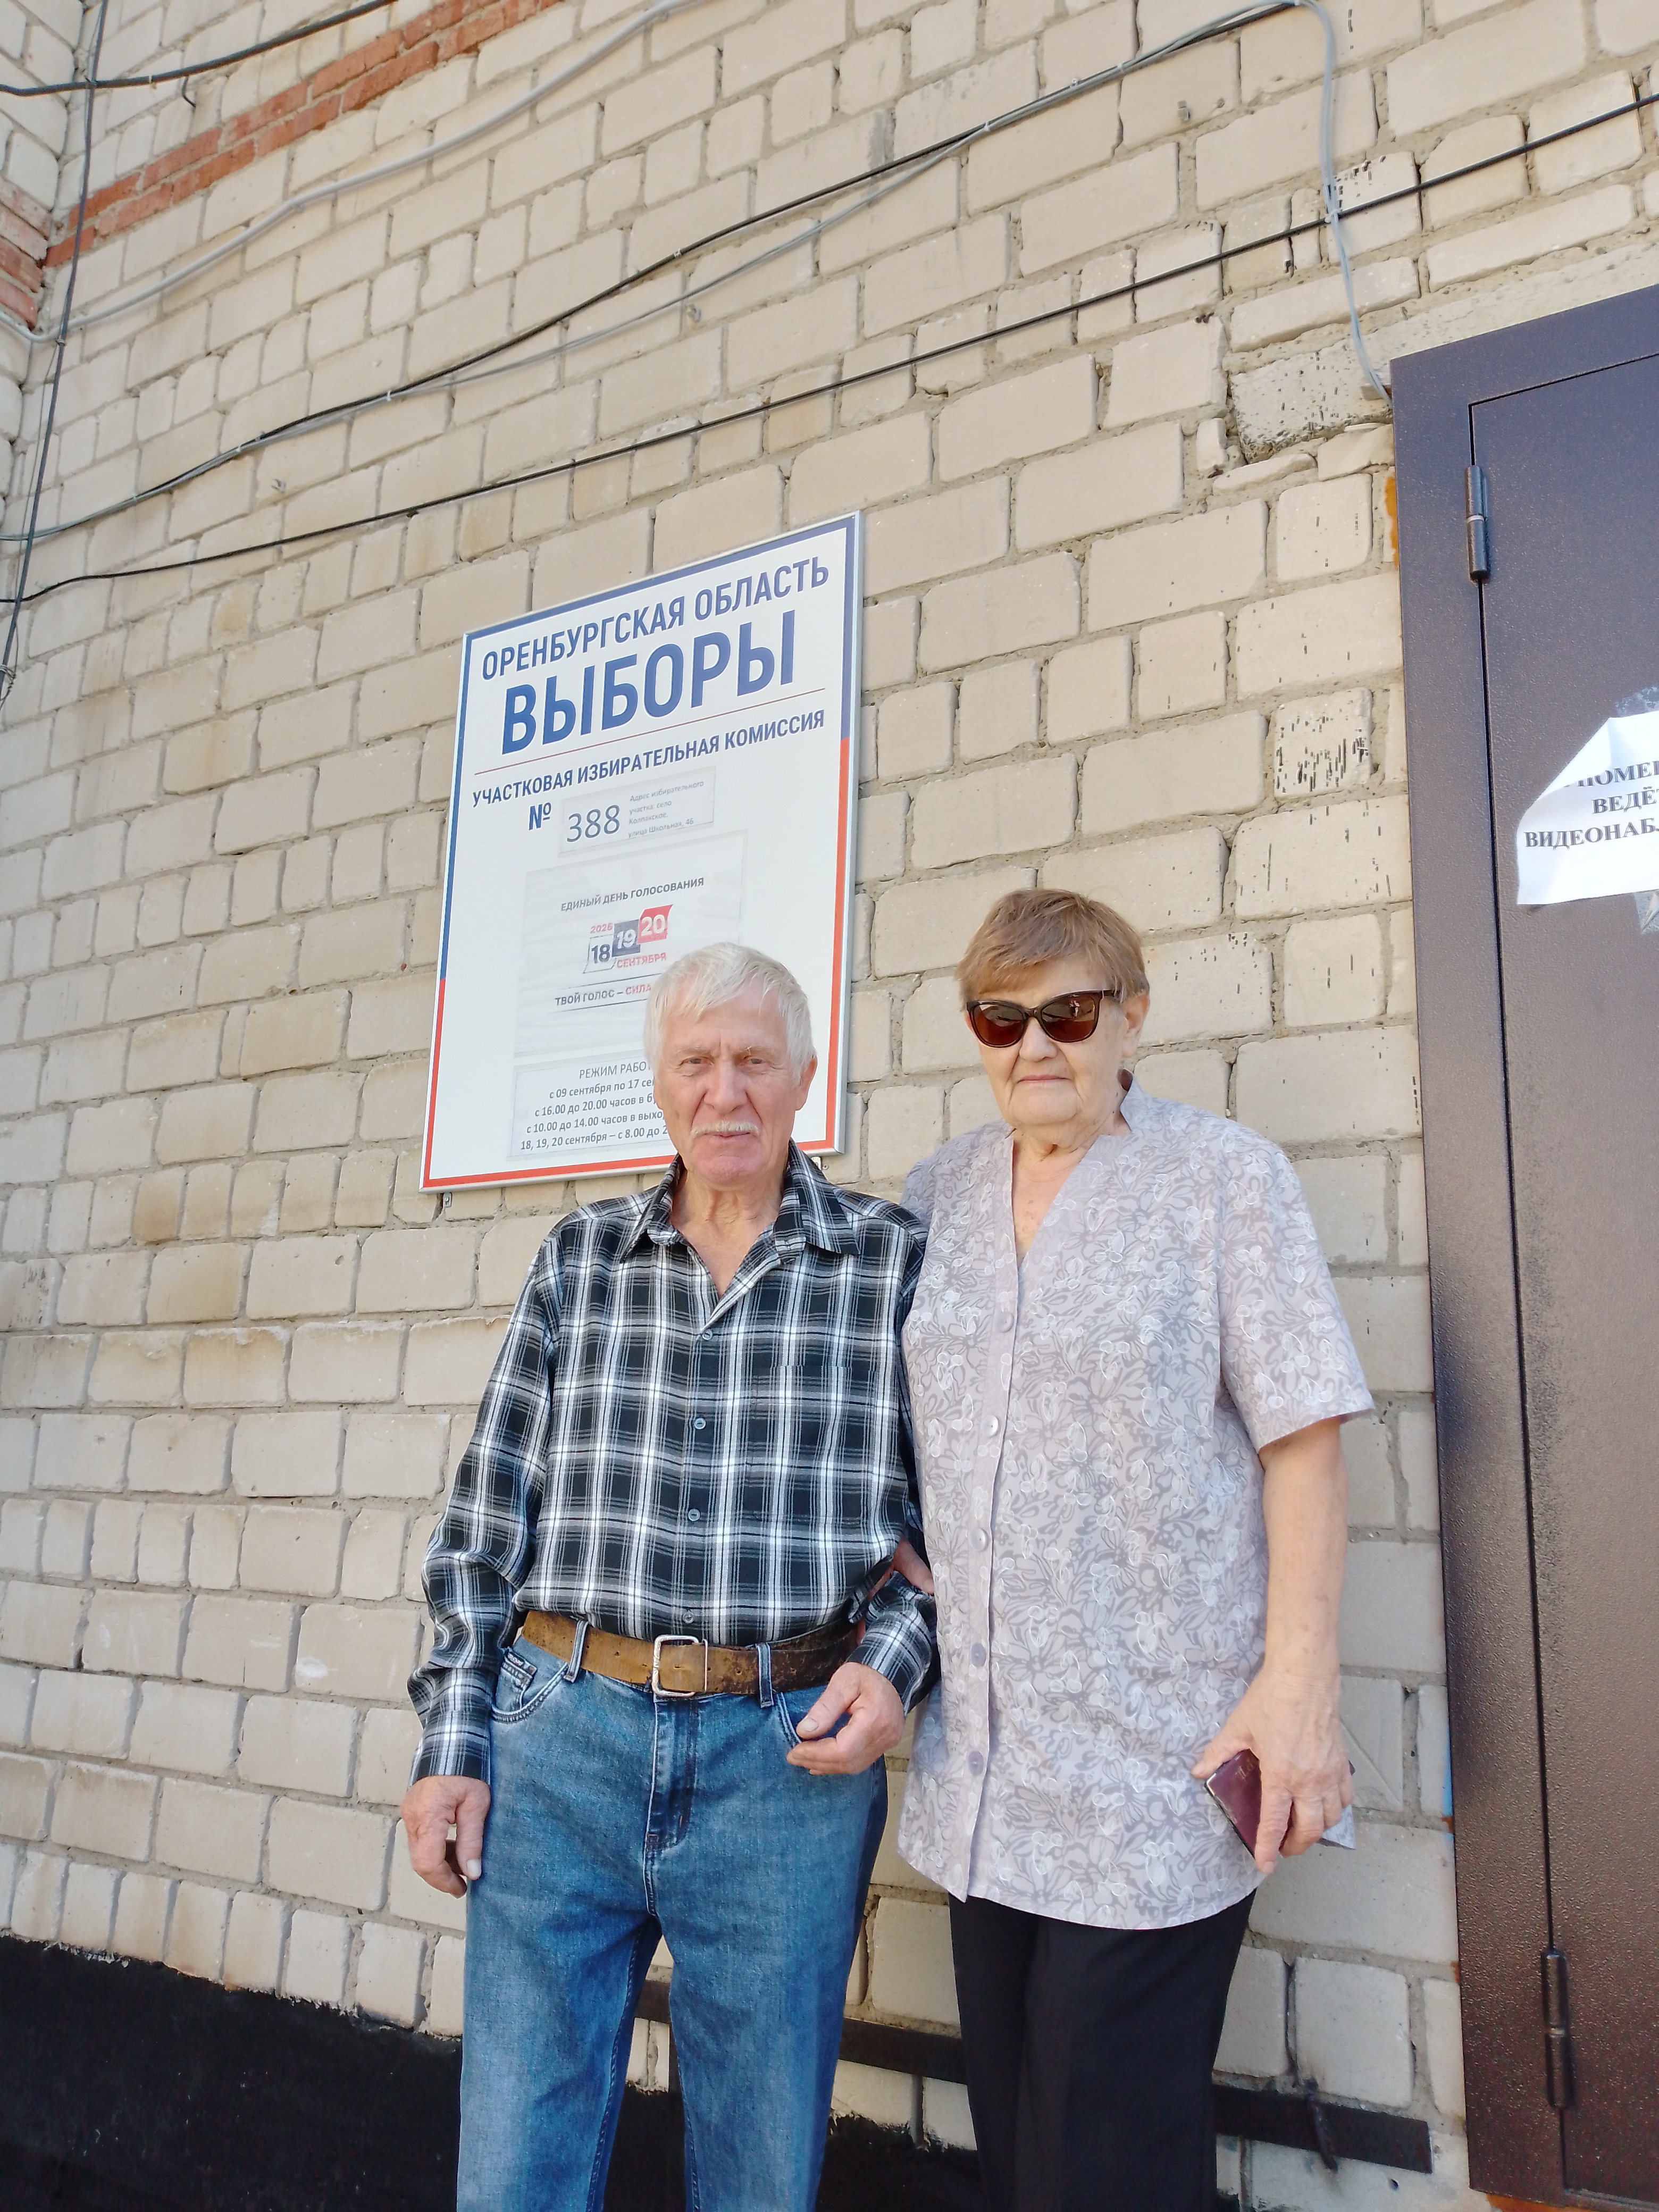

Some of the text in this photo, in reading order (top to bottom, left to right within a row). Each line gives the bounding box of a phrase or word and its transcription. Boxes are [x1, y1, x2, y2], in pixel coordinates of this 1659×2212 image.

[482, 556, 830, 681] ОРЕНБУРГСКАЯ ОБЛАСТЬ
[501, 610, 795, 755] ВЫБОРЫ
[473, 710, 824, 807] УЧАСТКОВАЯ ИЗБИРАТЕЛЬНАЯ КОМИССИЯ
[630, 781, 704, 802] Адрес избирательного
[1591, 786, 1659, 814] ВЕДЁ
[529, 802, 620, 843] № 388
[628, 829, 647, 838] улица
[649, 822, 684, 833] Школьная,
[1524, 818, 1659, 850] ВИДЕОНАБ
[560, 877, 704, 911] ЕДИНЫЙ ДЕНЬ ГОЛОСОВАНИЯ
[591, 914, 665, 964] 18 19 20
[617, 952, 667, 968] СЕНТЯБРЯ
[555, 992, 581, 1006] ТВОЙ
[582, 989, 615, 1002] ГОЛОС
[625, 984, 651, 995] СИЛА
[579, 1061, 650, 1079] РЕЖИМ РАБО
[556, 1088, 567, 1098] 09
[569, 1083, 611, 1096] сентября
[614, 1082, 625, 1091] по
[628, 1079, 640, 1089] 17
[542, 1104, 566, 1116] 16.00
[567, 1104, 580, 1115] до
[582, 1099, 607, 1111] 20.00
[609, 1096, 636, 1107] часов
[533, 1121, 557, 1133] 10.00
[559, 1121, 572, 1132] до
[574, 1116, 599, 1128] 14.00
[601, 1113, 627, 1125] часов
[638, 1111, 665, 1121] выхо
[521, 1139, 533, 1151] 18,
[536, 1138, 549, 1149] 19,
[552, 1136, 563, 1147] 20
[565, 1132, 607, 1145] сентября
[625, 1127, 644, 1138] 8.00
[646, 1128, 659, 1138] до
